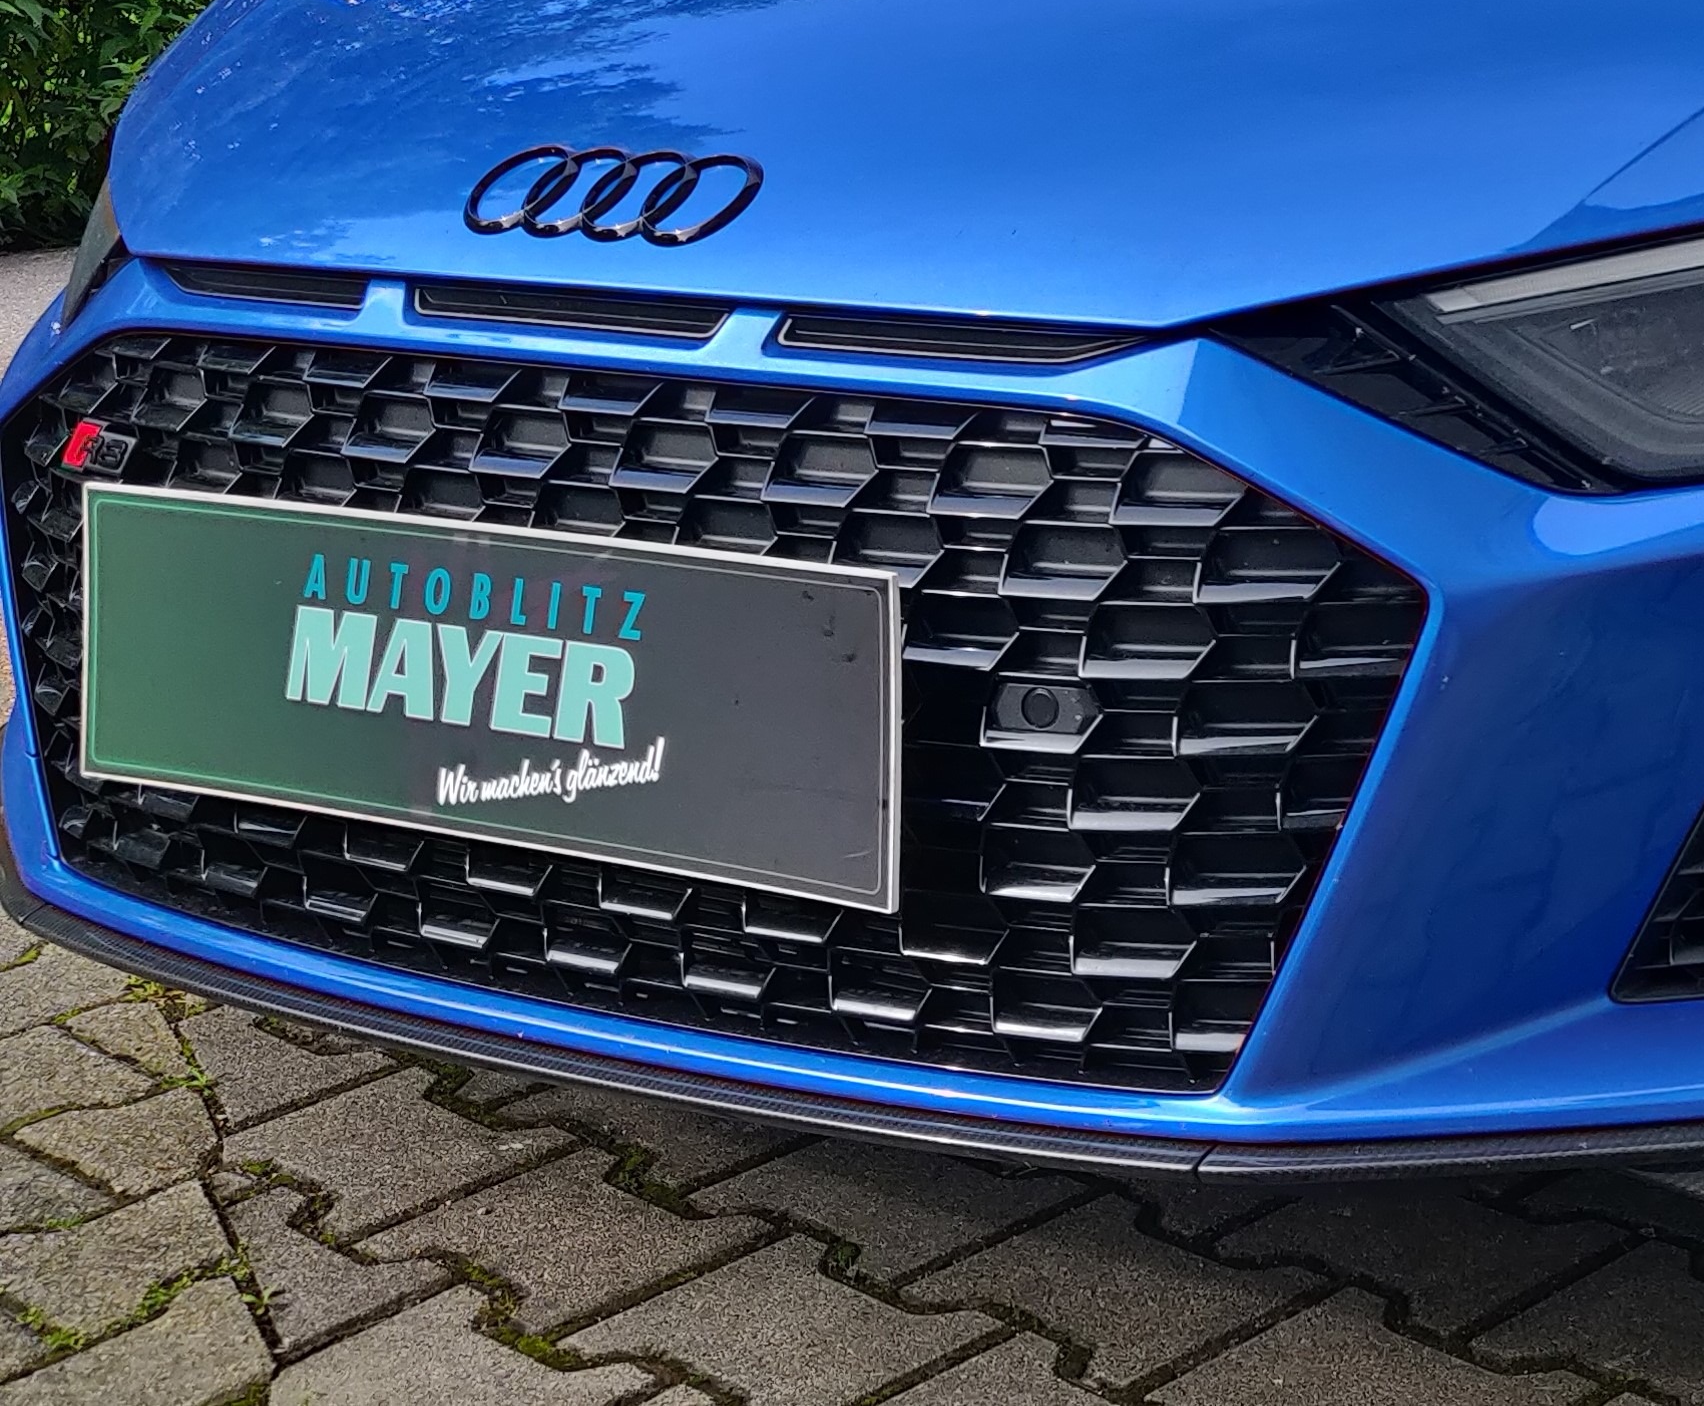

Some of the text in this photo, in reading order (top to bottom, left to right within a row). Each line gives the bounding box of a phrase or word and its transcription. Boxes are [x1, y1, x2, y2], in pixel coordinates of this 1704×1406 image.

[303, 553, 646, 641] AUTOBLITZ
[286, 604, 636, 749] MAYER
[437, 735, 666, 806] Wir machen's glänzend!
